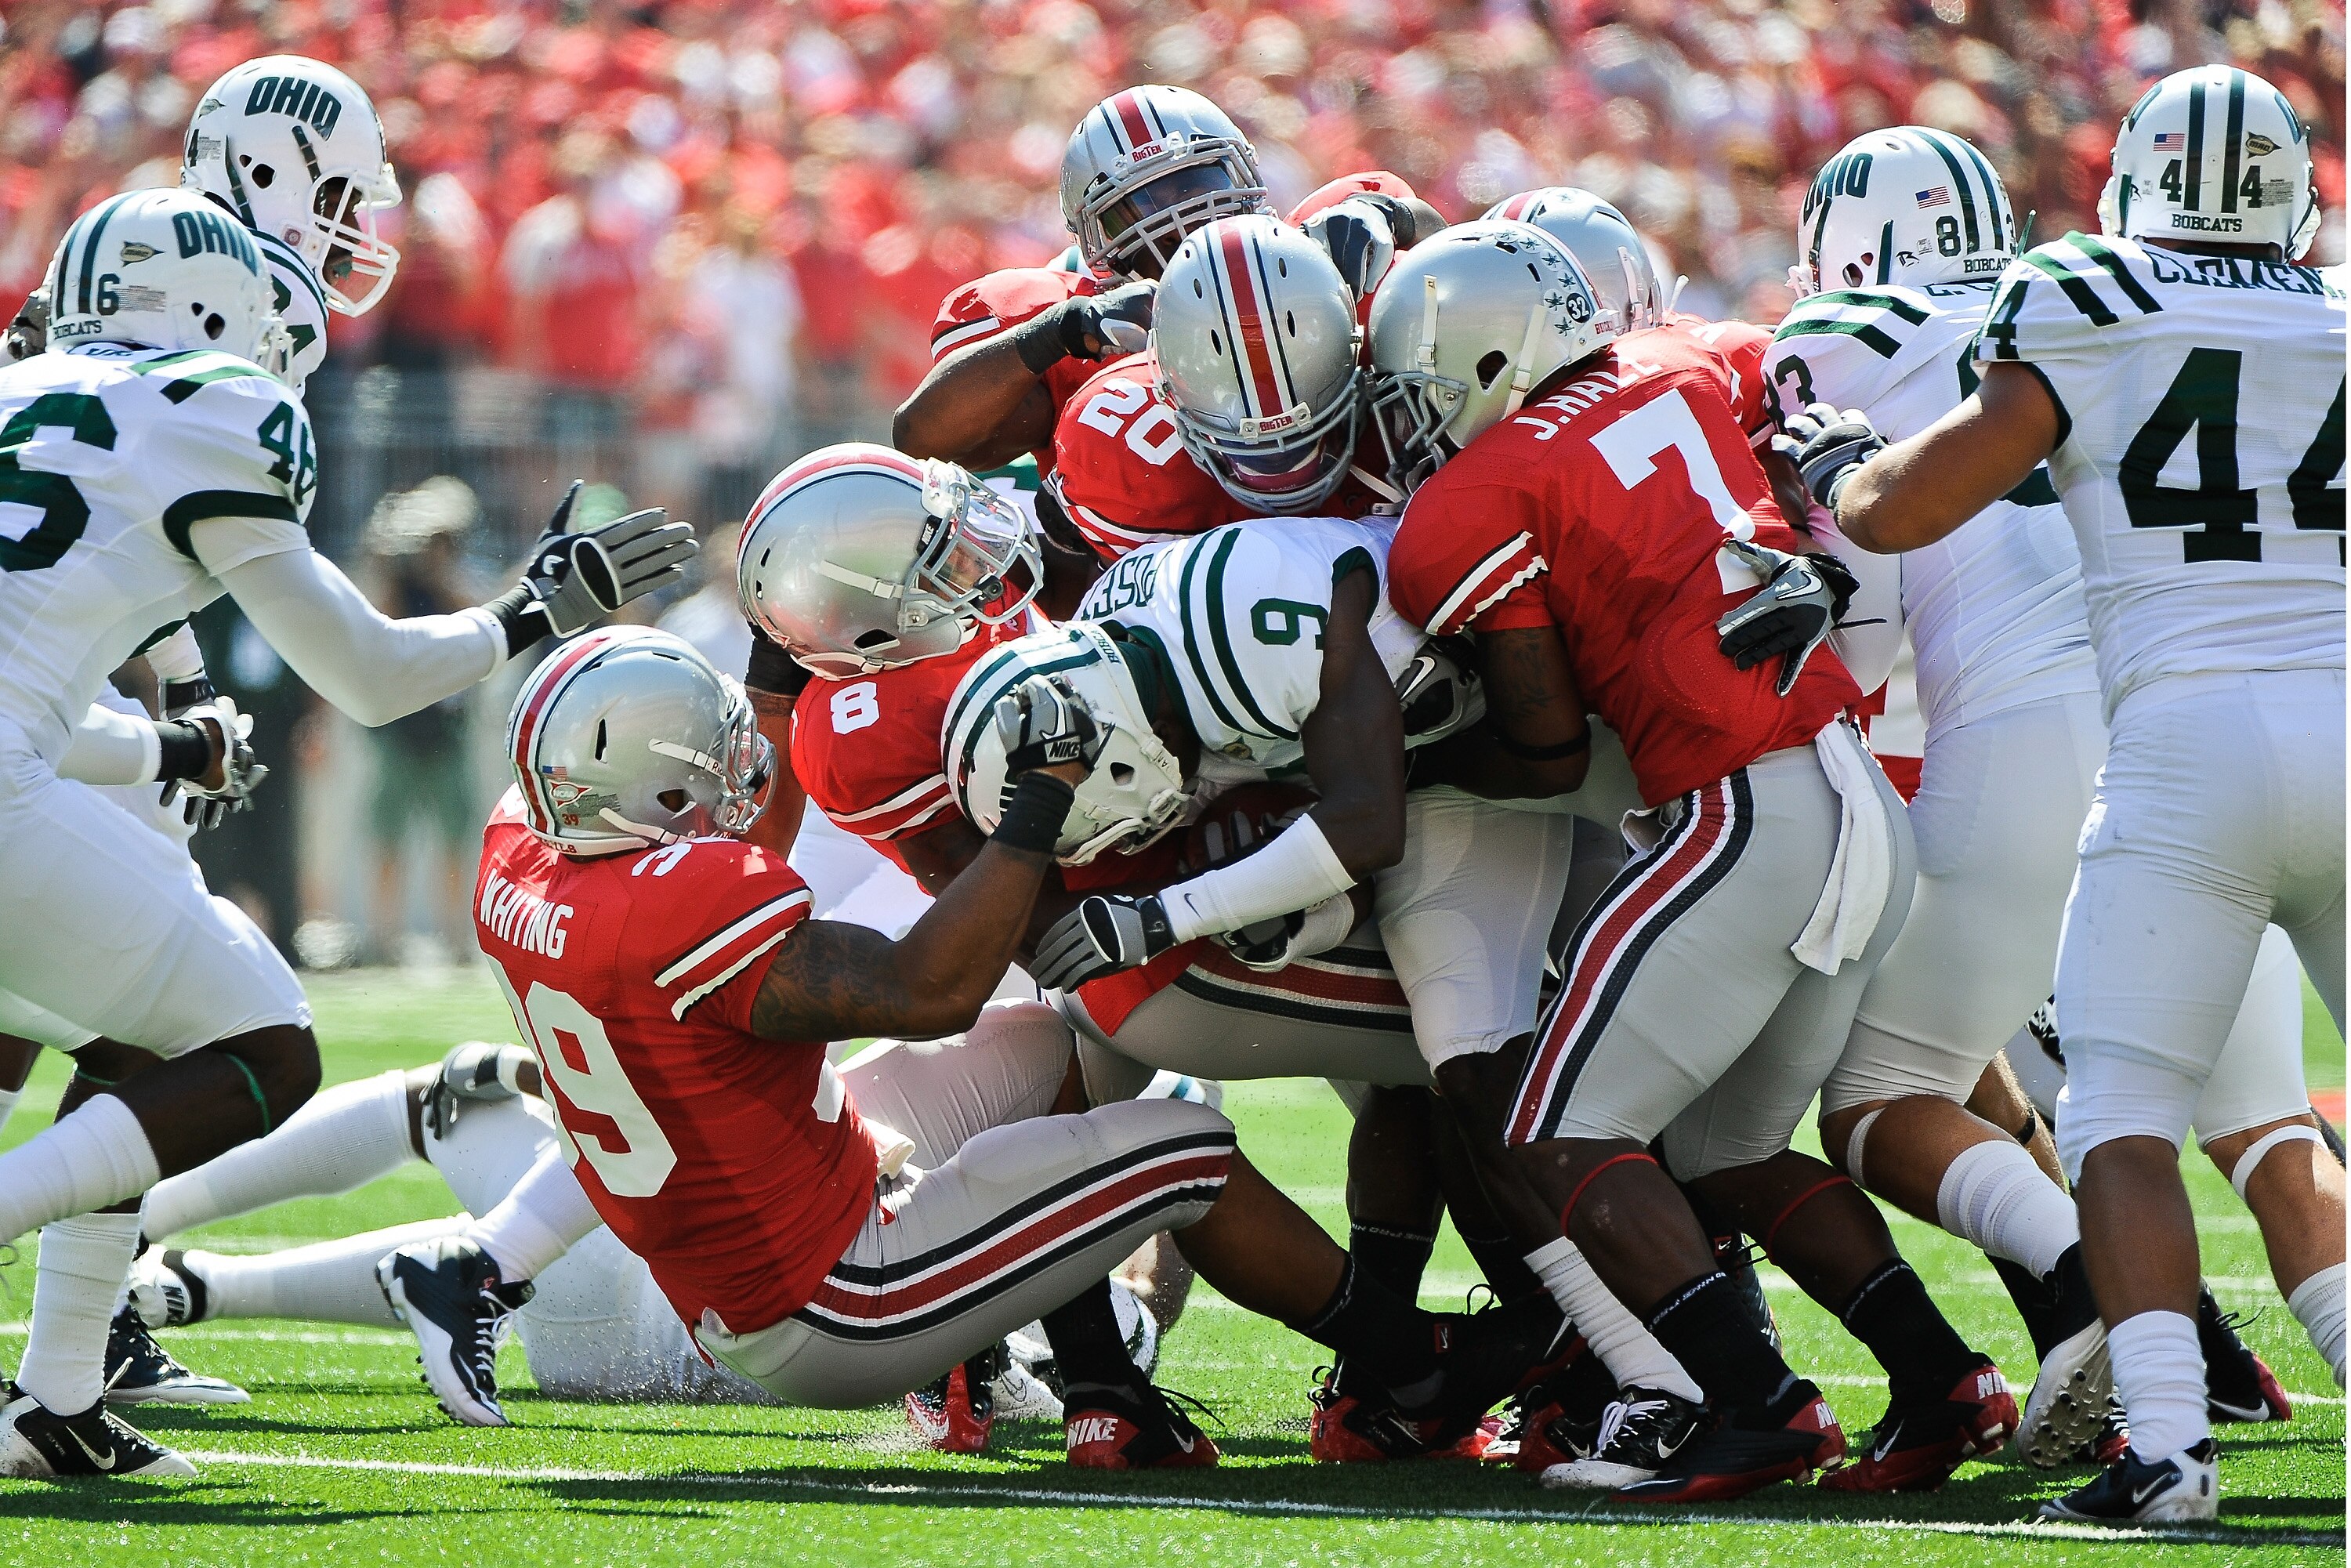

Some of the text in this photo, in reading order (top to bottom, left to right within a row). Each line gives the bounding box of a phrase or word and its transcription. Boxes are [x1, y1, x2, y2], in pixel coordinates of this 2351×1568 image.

[245, 77, 342, 141] OHIO
[1802, 153, 1874, 226] OHIO
[2159, 159, 2183, 202] 4
[2240, 165, 2263, 208] 4
[172, 211, 258, 277] OHIO
[1935, 215, 1961, 257] 8
[2172, 213, 2243, 233] BOBCATS
[97, 273, 120, 315] 6
[2142, 249, 2346, 299] CLEMEN
[53, 320, 103, 340] BOBCATS
[1568, 297, 1589, 319] 32
[1078, 378, 1185, 465] 20
[257, 400, 317, 505] 46
[1588, 388, 1762, 594] 7
[921, 523, 935, 545] NIKE
[830, 681, 880, 734] 8
[1049, 741, 1081, 759] NIKE
[562, 813, 580, 826] 39
[480, 869, 574, 960] WHITING
[1976, 1371, 2008, 1400] NI
[1067, 1418, 1119, 1450] NIKE
